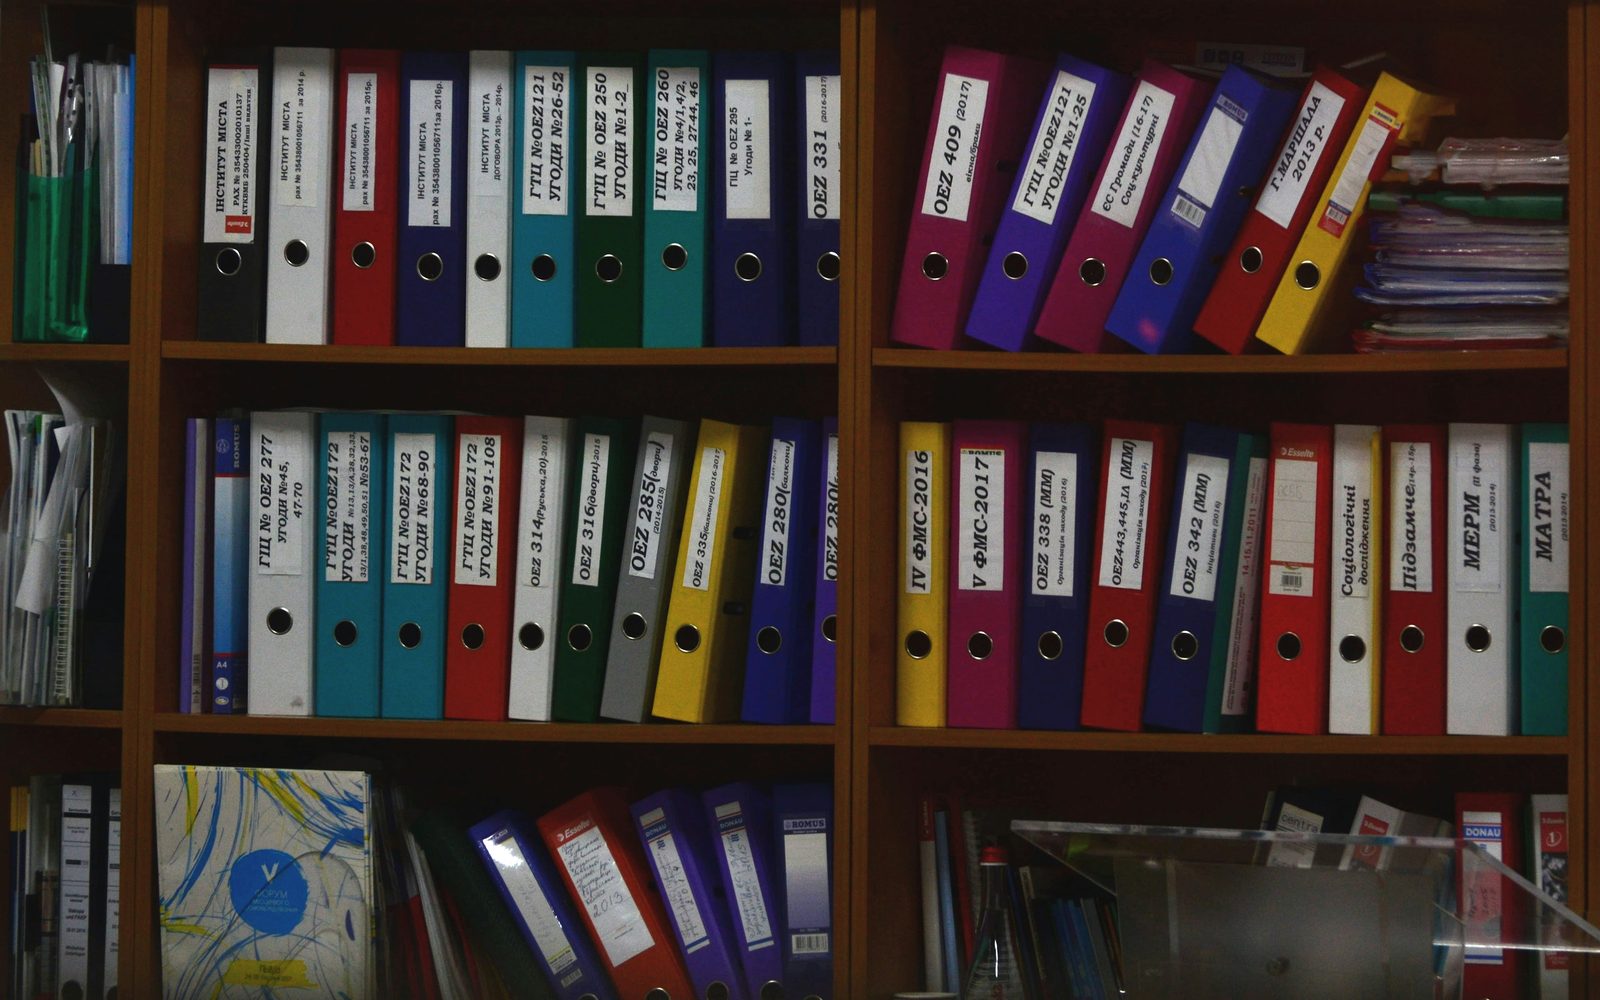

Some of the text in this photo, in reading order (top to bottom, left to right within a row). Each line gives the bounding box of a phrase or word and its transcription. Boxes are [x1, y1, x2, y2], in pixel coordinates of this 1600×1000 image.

[595, 73, 607, 106] 250
[657, 69, 670, 102] 260
[689, 81, 698, 98] 46
[234, 93, 243, 172] 35433002010137
[481, 93, 490, 173] ІНСТИТУТ МІСТА
[549, 71, 564, 201] УГОДИ №26-52
[595, 110, 607, 145] OEZ
[656, 107, 669, 142] OEZ
[730, 107, 738, 125] 295
[730, 127, 738, 150] OEZ
[744, 130, 752, 142] №
[215, 101, 227, 212] ІНСТИТУТ МІСТА
[281, 102, 290, 181] ІНСТИТУТ МІСТА
[294, 174, 301, 184] №
[298, 99, 304, 107] за
[349, 123, 358, 189] ІНСТИТУТ МІСТА
[362, 180, 368, 189] №
[365, 106, 371, 115] за
[417, 122, 427, 199] ІНСТИТУТ МІСТА
[594, 151, 606, 169] №
[656, 147, 668, 166] №
[730, 153, 738, 164] №
[744, 145, 753, 176] Угоди
[813, 130, 827, 168] 331
[934, 81, 972, 215] OEZ 409 (2017)
[965, 123, 981, 183] вікна/брами
[1042, 94, 1087, 210] УГОДИ №1-25
[1102, 95, 1153, 212] ЄС Громади (16-17)
[1121, 114, 1160, 206] Соц-культурні
[1270, 96, 1322, 192] Г.МАРШАЛА
[1292, 124, 1325, 182] 2013 р.
[234, 175, 240, 185] №
[614, 140, 628, 199] УГОДИ
[674, 146, 684, 191] УГОДИ
[687, 171, 698, 191] 23,
[432, 196, 439, 207] №
[432, 209, 440, 225] рах
[813, 175, 827, 218] OEZ
[261, 434, 273, 468] 277
[359, 436, 369, 487] №53-67
[1120, 440, 1136, 480] (ММ)
[1287, 448, 1314, 458] Esselte
[260, 473, 272, 508] OEZ
[278, 461, 289, 543] УГОДИ №45,
[294, 482, 303, 518] 47-70
[480, 437, 495, 579] УГОДИ №91-108
[653, 487, 665, 534] (2014-2015)
[1060, 478, 1068, 504] (2016)
[1137, 489, 1147, 517] заходу
[1463, 492, 1481, 571] МЕРМ
[1473, 442, 1482, 473] фаза)
[1489, 483, 1497, 532] (2013-2014)
[260, 514, 271, 533] №
[416, 450, 429, 582] УГОДИ №68-90
[912, 451, 928, 590] IV ФМС-2016
[973, 457, 989, 588] V ФМС-2017
[1037, 469, 1055, 590] OEZ 338 (ММ)
[1183, 473, 1211, 594] OEZ 342 (ММ)
[1534, 471, 1553, 562] МАТРА
[342, 522, 355, 582] УГОДИ
[580, 544, 592, 580] OEZ
[631, 526, 650, 571] OEZ
[768, 539, 784, 584] OEZ
[1057, 536, 1066, 585] Організація
[1133, 519, 1143, 569] Організація
[1341, 485, 1357, 596] Соціологічні
[1358, 498, 1370, 585] дослідження
[531, 557, 541, 587] OEZ
[693, 561, 704, 587] OEZ
[216, 661, 227, 669] A4
[1465, 828, 1501, 837] DONAU
[593, 892, 623, 918] 2013
